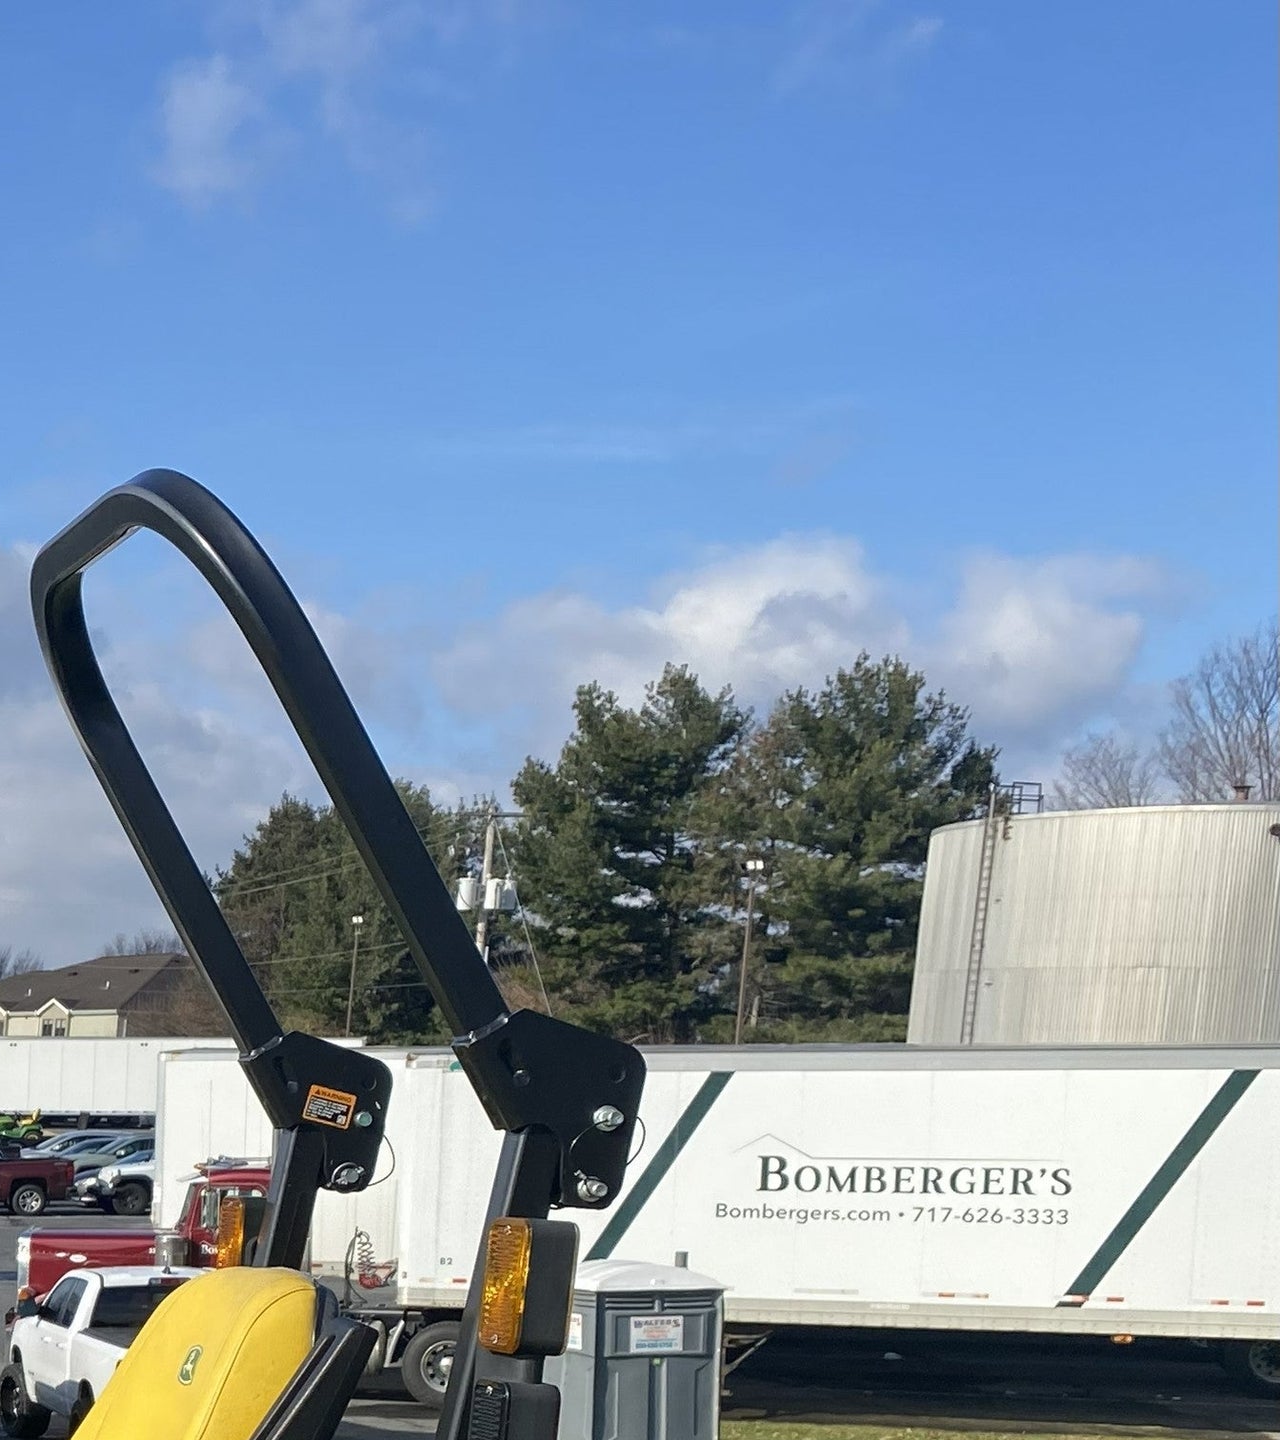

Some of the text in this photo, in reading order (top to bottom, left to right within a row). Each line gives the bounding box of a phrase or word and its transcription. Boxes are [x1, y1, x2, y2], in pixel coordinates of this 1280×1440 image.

[756, 1155, 1072, 1196] BOMBERGER'S
[715, 1203, 1069, 1225] Bombergers.com 717-626-3333
